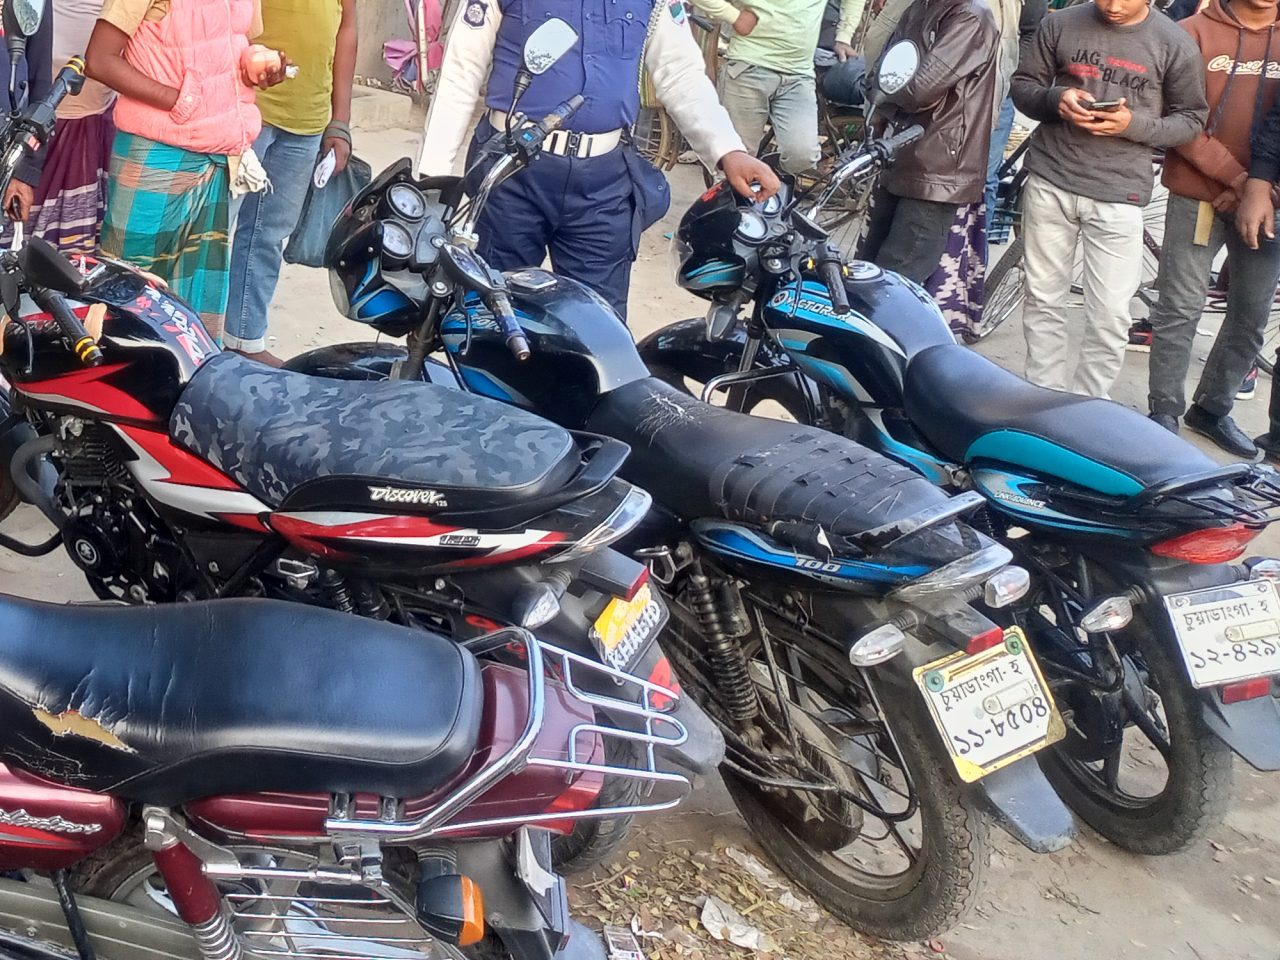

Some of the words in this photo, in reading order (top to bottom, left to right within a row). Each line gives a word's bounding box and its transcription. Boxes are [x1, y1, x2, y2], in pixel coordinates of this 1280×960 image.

[1102, 68, 1150, 92] BLACK
[368, 485, 445, 504] Discover
[1190, 639, 1280, 669] ১২-৪২৯
